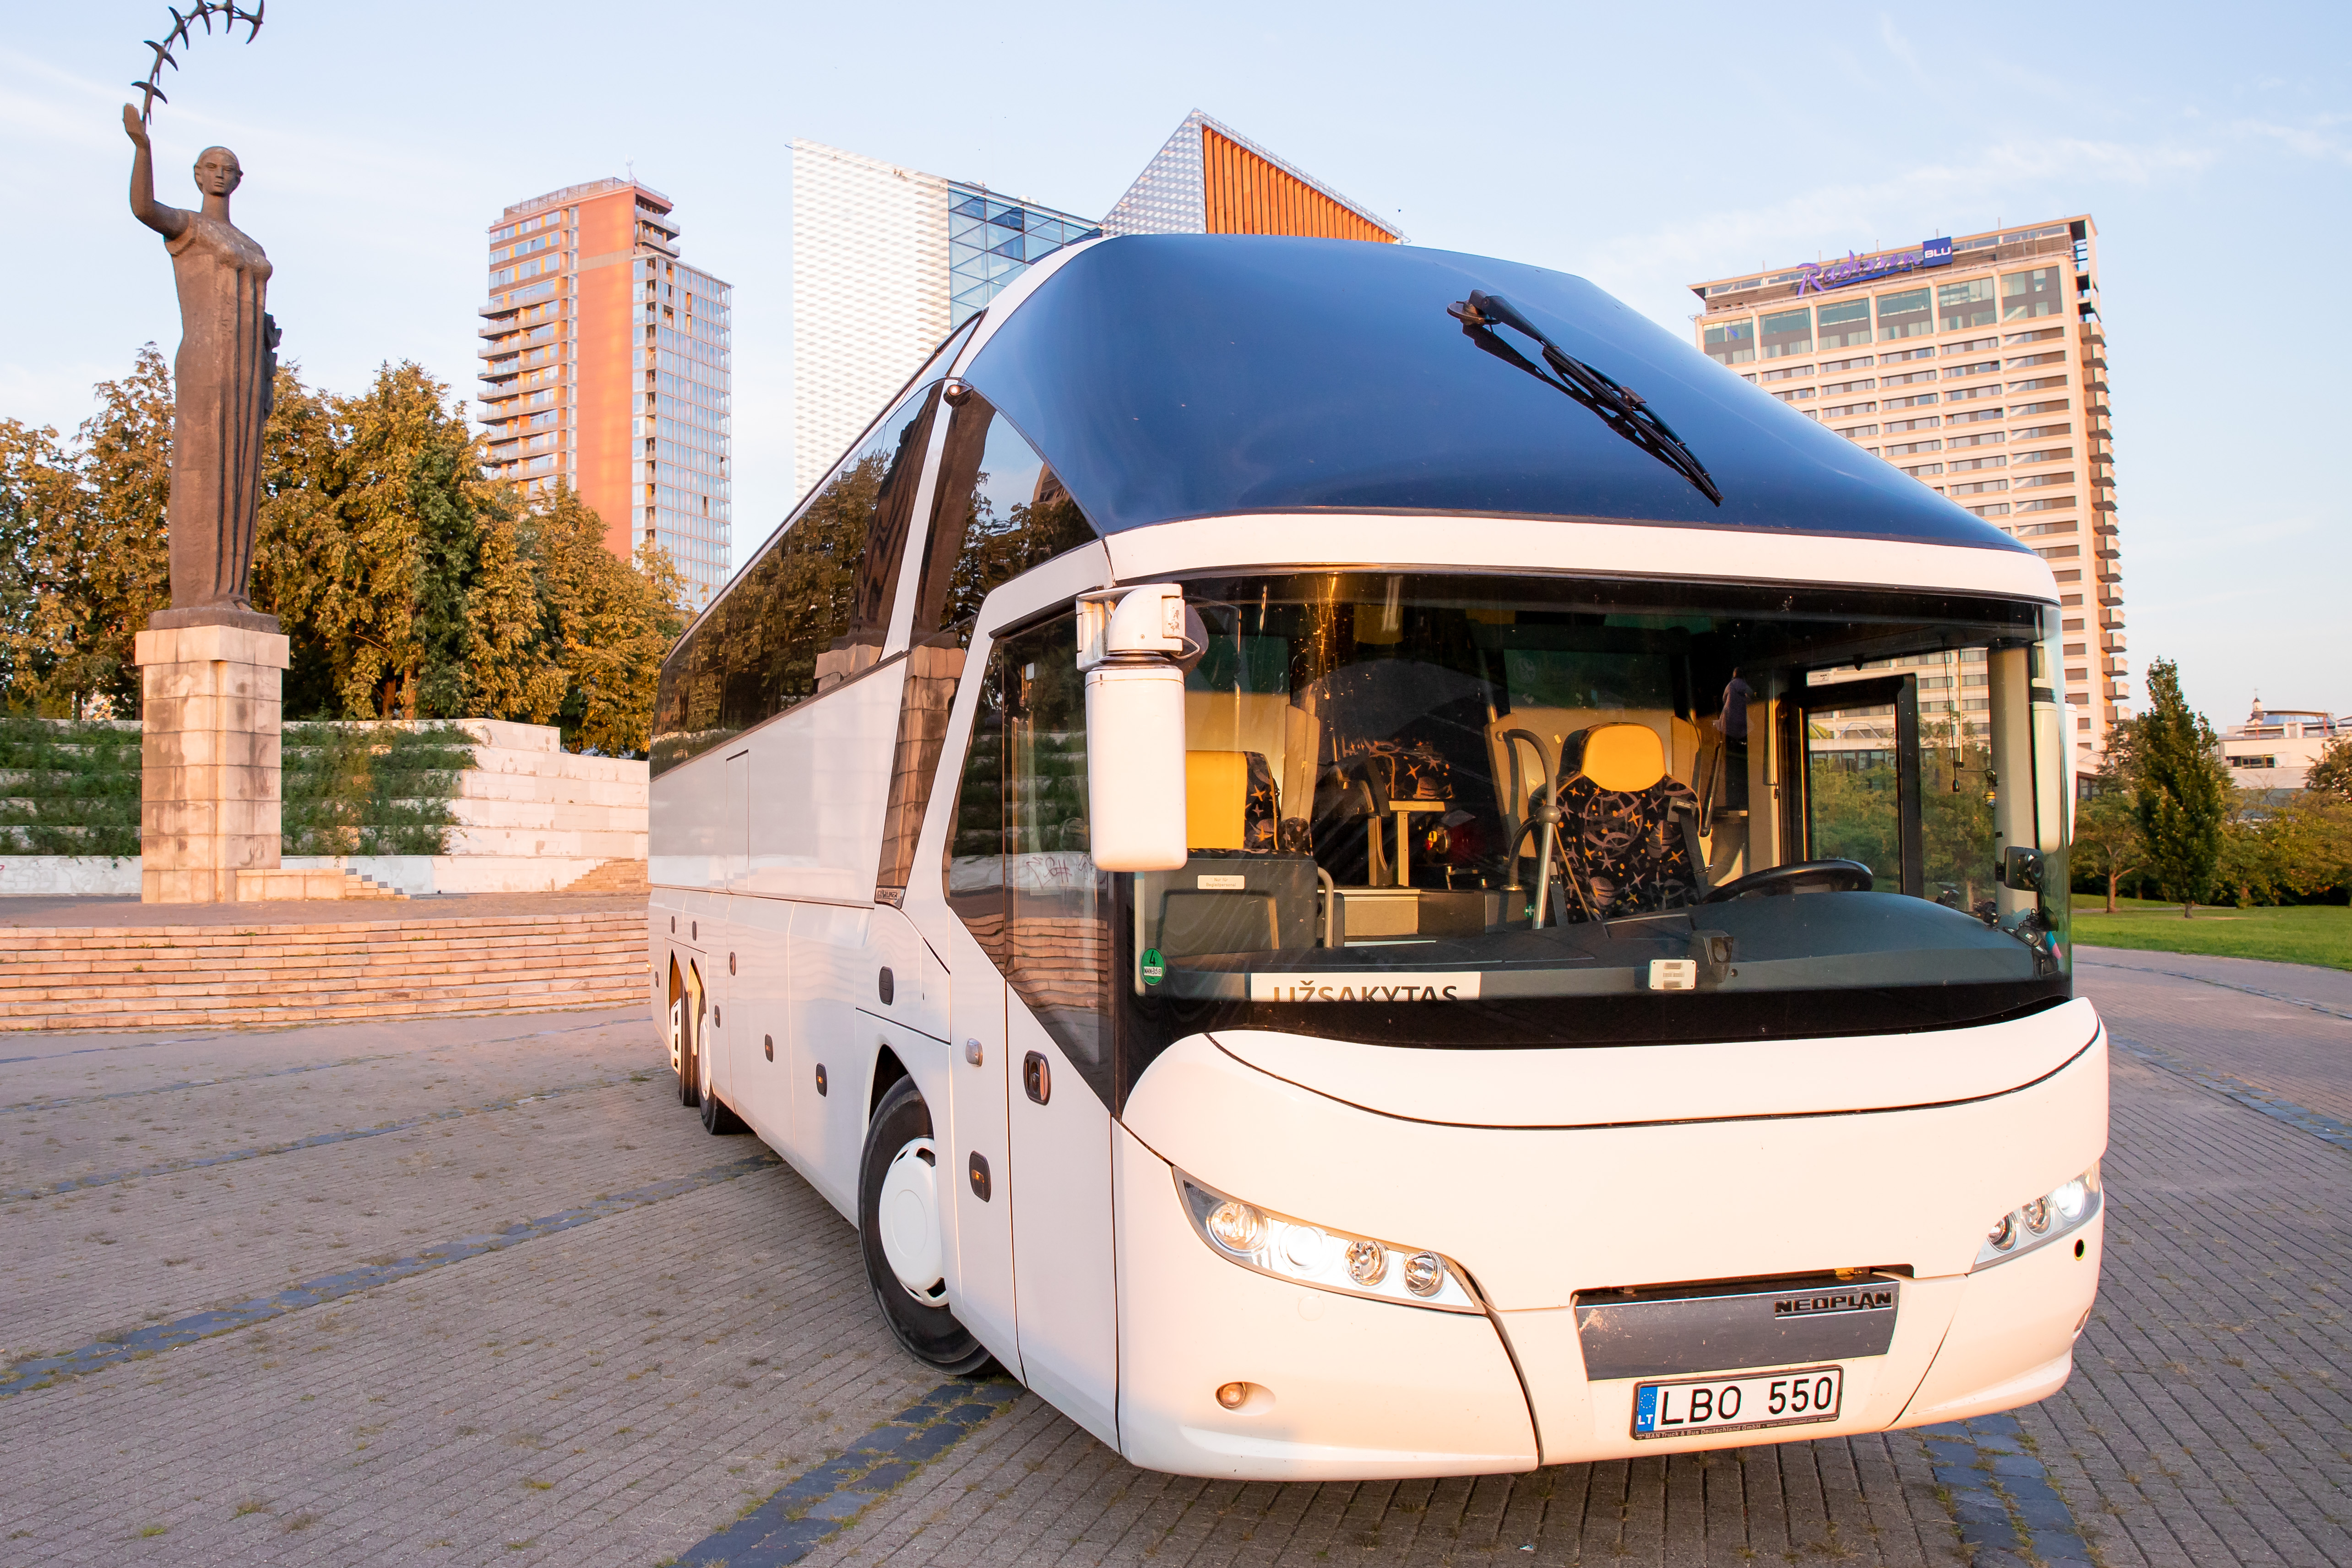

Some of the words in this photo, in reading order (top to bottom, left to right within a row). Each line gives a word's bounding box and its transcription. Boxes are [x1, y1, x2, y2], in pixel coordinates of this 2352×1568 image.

[1797, 250, 1921, 298] Radisson
[1924, 246, 1951, 258] BLU
[1150, 950, 1156, 966] 4
[1775, 1292, 1892, 1313] NEOPLAN
[1661, 1386, 1741, 1425] LBO
[1768, 1377, 1832, 1414] 550
[1638, 1414, 1653, 1425] LT
[1701, 1425, 1740, 1434] Deutschland
